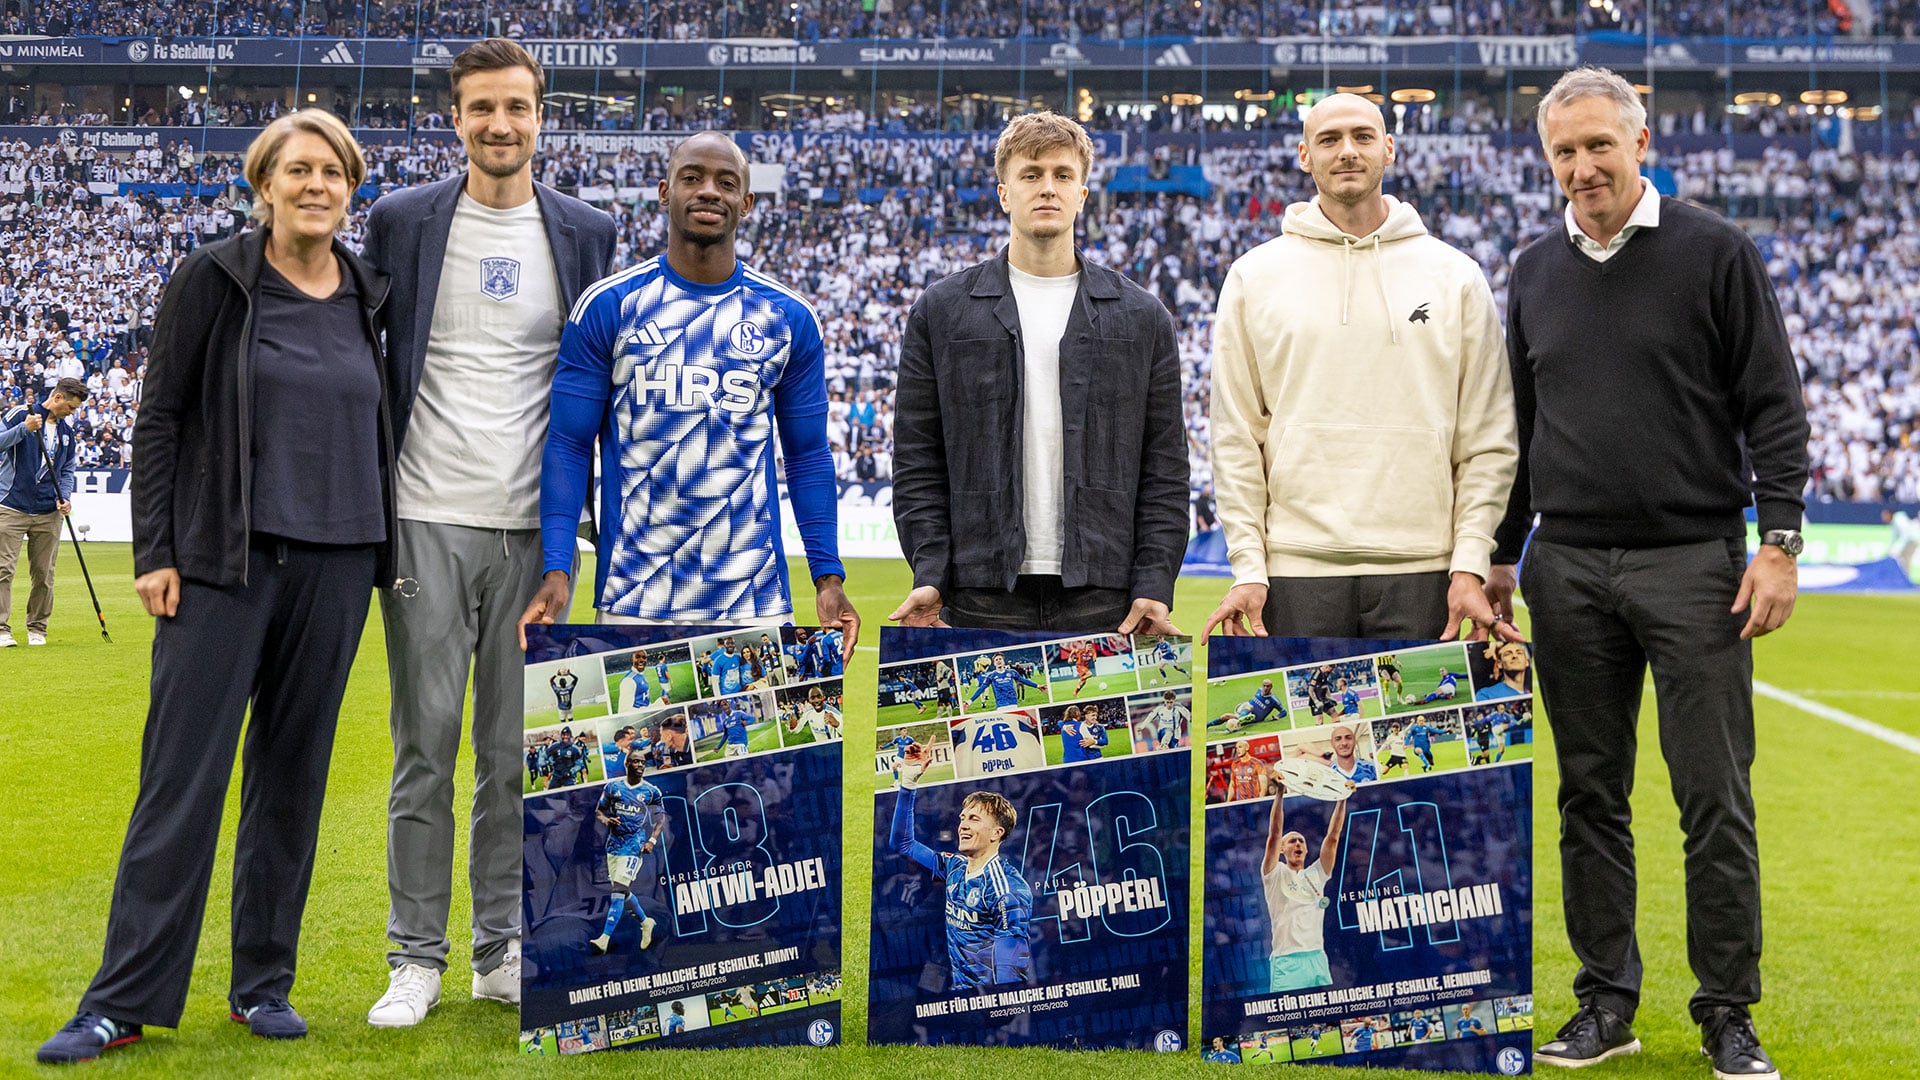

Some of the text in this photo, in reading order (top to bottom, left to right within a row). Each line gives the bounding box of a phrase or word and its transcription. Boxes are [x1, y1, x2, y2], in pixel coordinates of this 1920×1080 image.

[17, 46, 84, 57] MINIMEAL
[153, 43, 234, 59] FC Schalke 04
[526, 44, 618, 66] VELTINS
[733, 46, 816, 63] FC Schalke 04
[859, 48, 994, 62] SUN MINIMEAL
[1478, 42, 1578, 67] VELTINS
[102, 132, 143, 146] Schalke
[635, 364, 759, 413] HRS
[972, 723, 1018, 754] 46
[614, 802, 641, 813] SUN
[626, 856, 637, 870] 18
[649, 783, 780, 938] 18
[659, 860, 753, 886] CHRISTOPHER
[1021, 791, 1171, 944] 46
[676, 857, 826, 916] ANTWI-ADJEI
[1035, 878, 1067, 890] PAUL
[1337, 801, 1460, 952] 41
[1057, 876, 1166, 921] PÖPPERL
[1340, 885, 1400, 902] HENNING
[945, 900, 978, 923] SUN
[1355, 883, 1503, 934] MATRICIANI
[568, 946, 799, 1005] DANKE FÜR DEINE MALOCHE AUF SCHALKE, JIMMY!
[649, 983, 685, 998] 2024/2025
[691, 976, 727, 989] 2025/2026
[915, 973, 1141, 1018] DANKE FÜR DEINE MALOCHE AUF SCHALKE, PAUL!
[1244, 969, 1492, 1016] DANKE FÜR DEINE MALOCHE AUF SCHALKE, HENNING!
[989, 1006, 1026, 1018] 2023/2024
[1032, 1000, 1068, 1012] 2025/2026
[1266, 1011, 1302, 1023] 2020/2021
[1308, 1006, 1343, 1018] 2021/2022
[1350, 1000, 1387, 1012] 2022/2023
[1393, 995, 1430, 1006] 2023/2024
[1436, 988, 1474, 1000] 2025/2026
